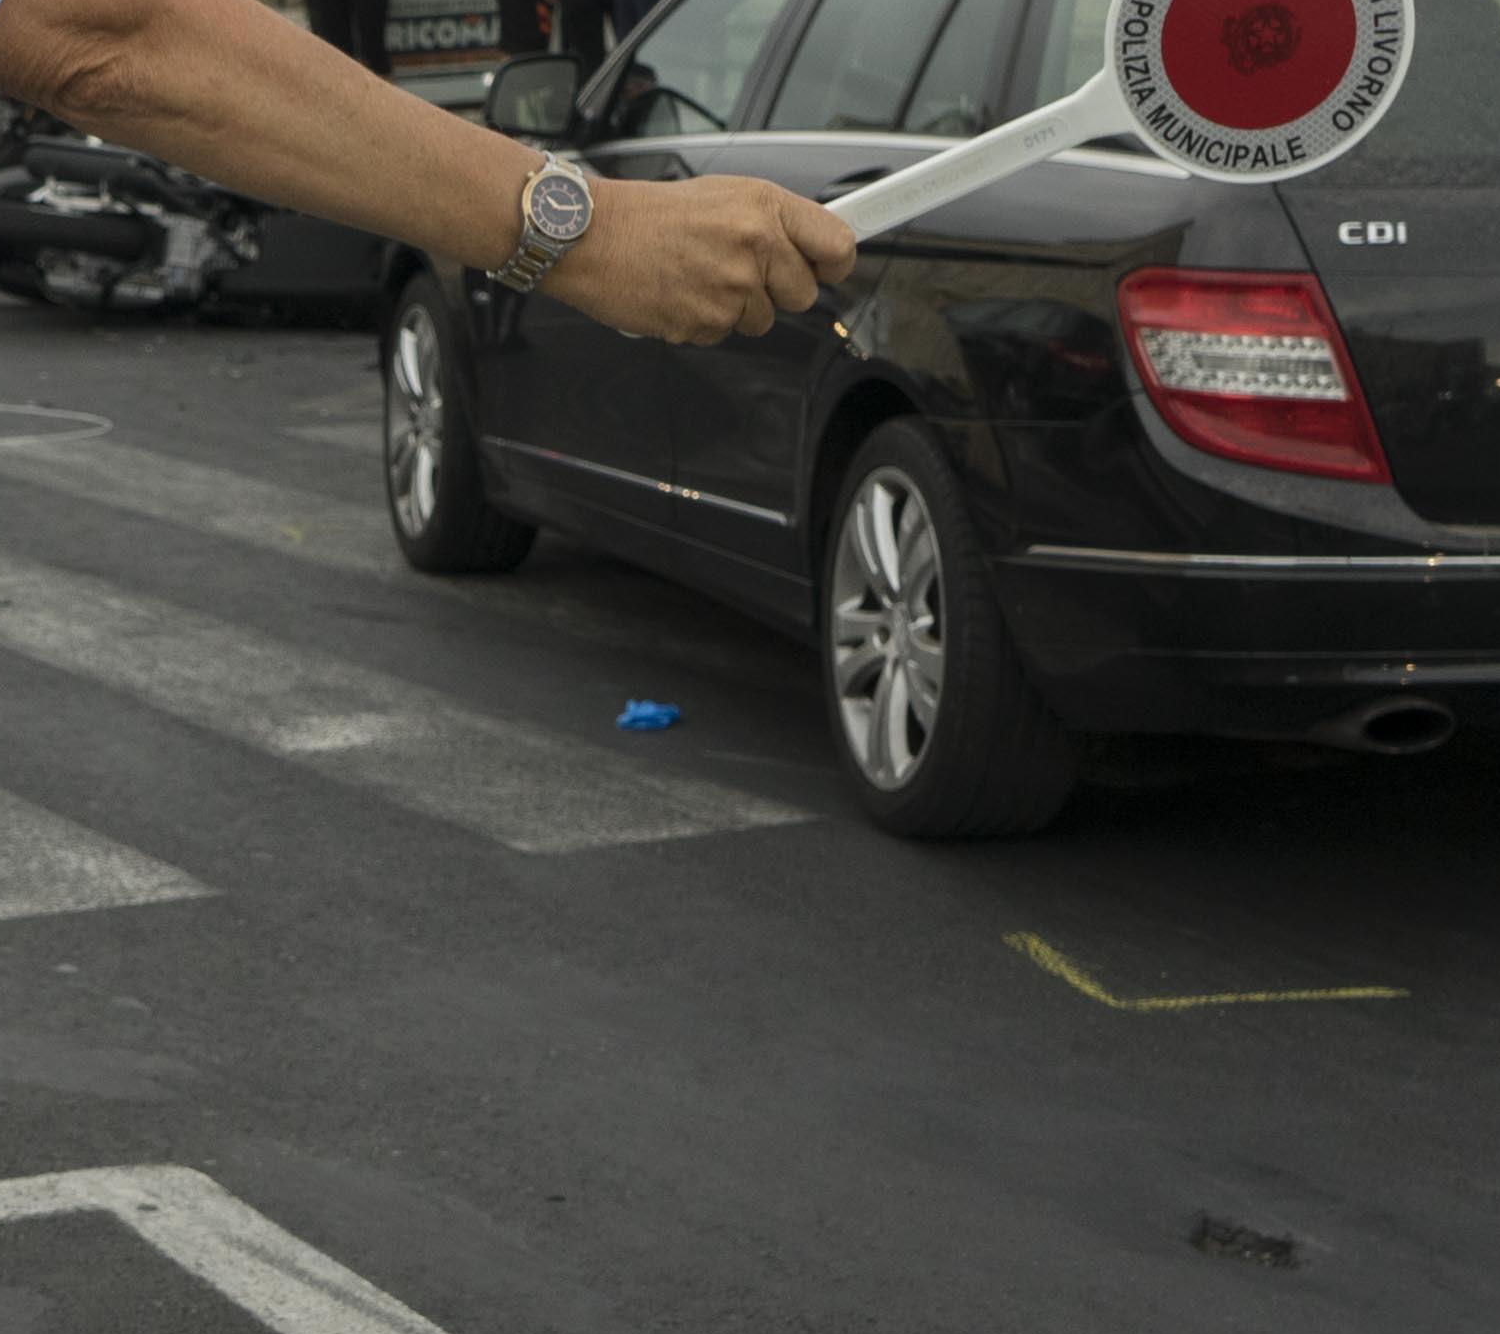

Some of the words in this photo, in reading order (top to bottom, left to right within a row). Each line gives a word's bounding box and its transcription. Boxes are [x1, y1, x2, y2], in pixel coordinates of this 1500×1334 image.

[1122, 0, 1156, 107] POLIZIA
[1146, 103, 1307, 168] MUNICIPALE
[1332, 10, 1399, 133] LIVORNO
[1338, 220, 1408, 245] CDI
